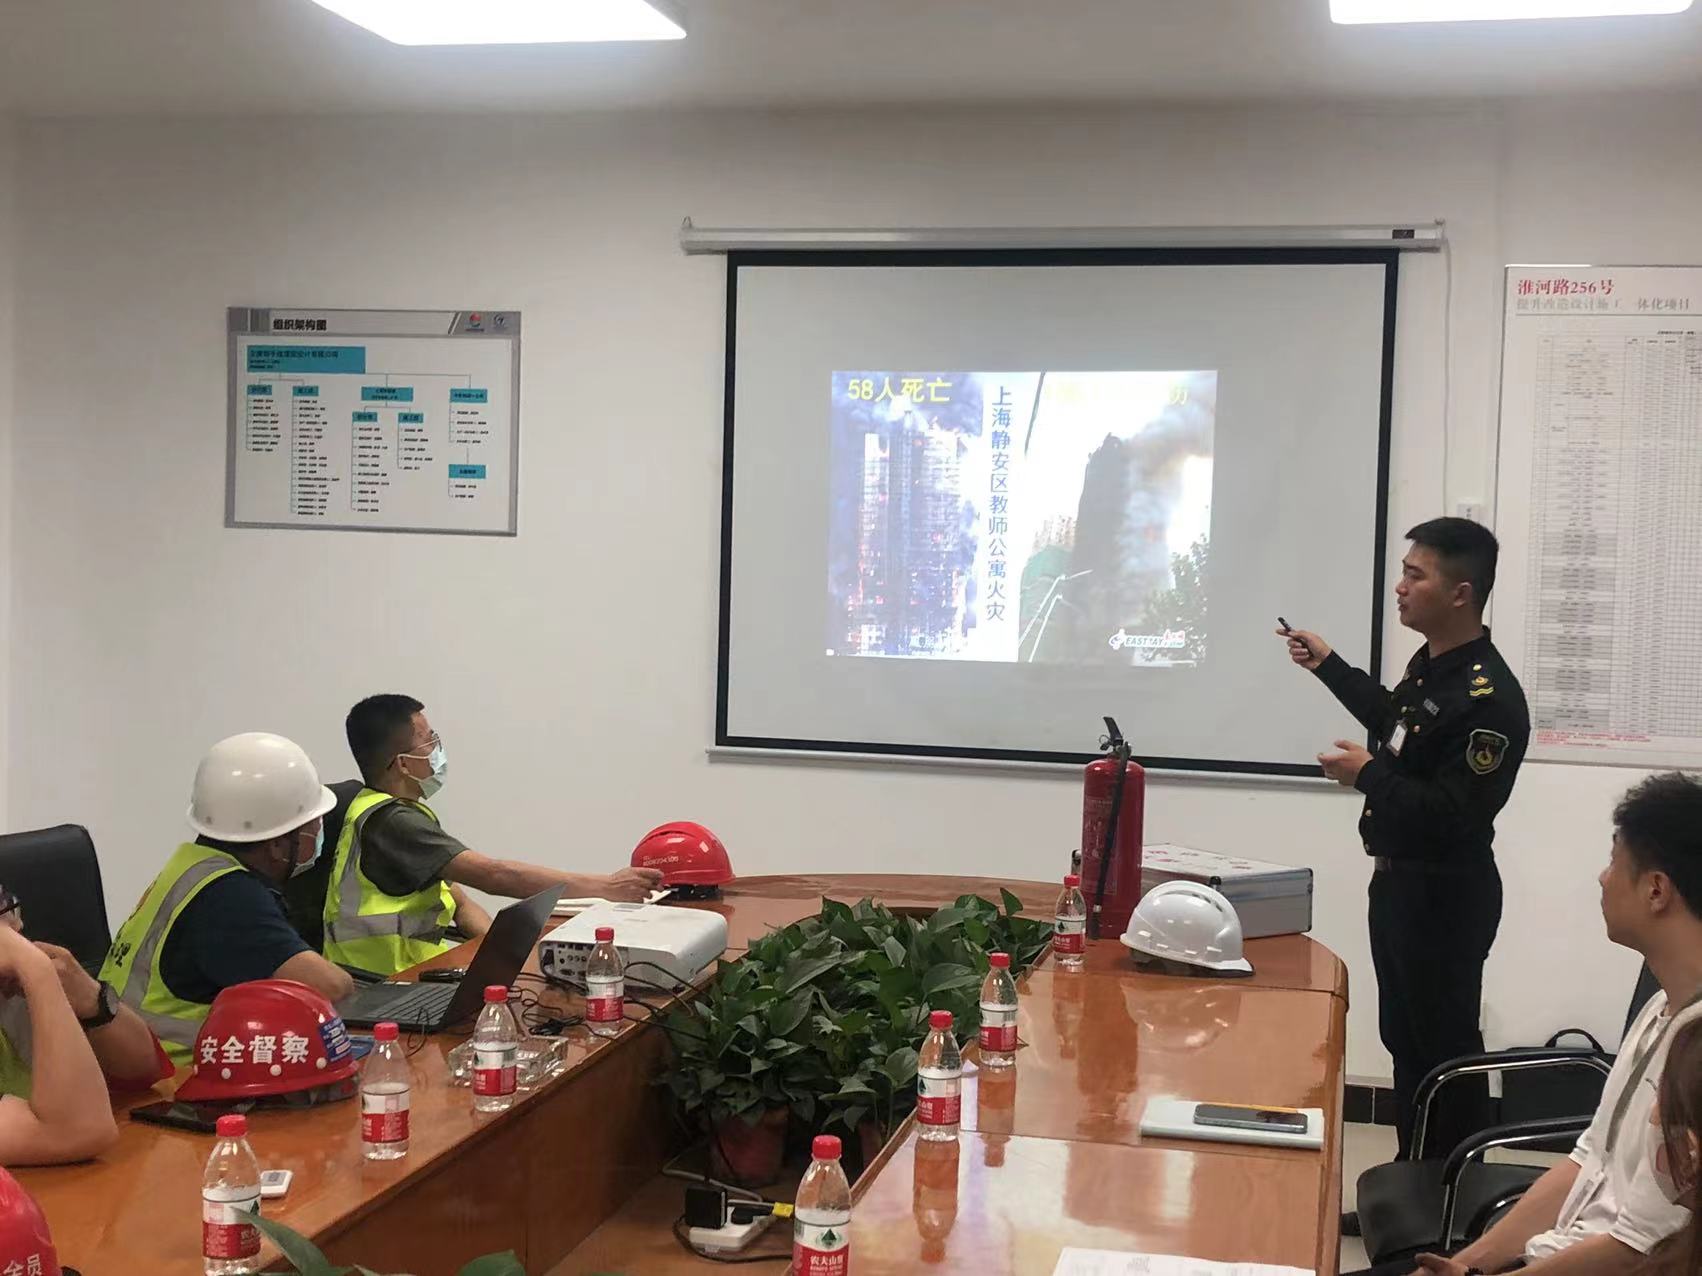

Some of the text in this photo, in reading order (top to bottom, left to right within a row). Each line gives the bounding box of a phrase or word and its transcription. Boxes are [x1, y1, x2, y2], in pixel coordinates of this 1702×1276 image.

[1517, 278, 1614, 296] 淮河路256号
[273, 318, 327, 332] 组织架构图
[847, 377, 953, 404] 58人死亡
[986, 385, 1014, 622] 上海静安区教师公寓火灾
[200, 1033, 310, 1065] 安全督察
